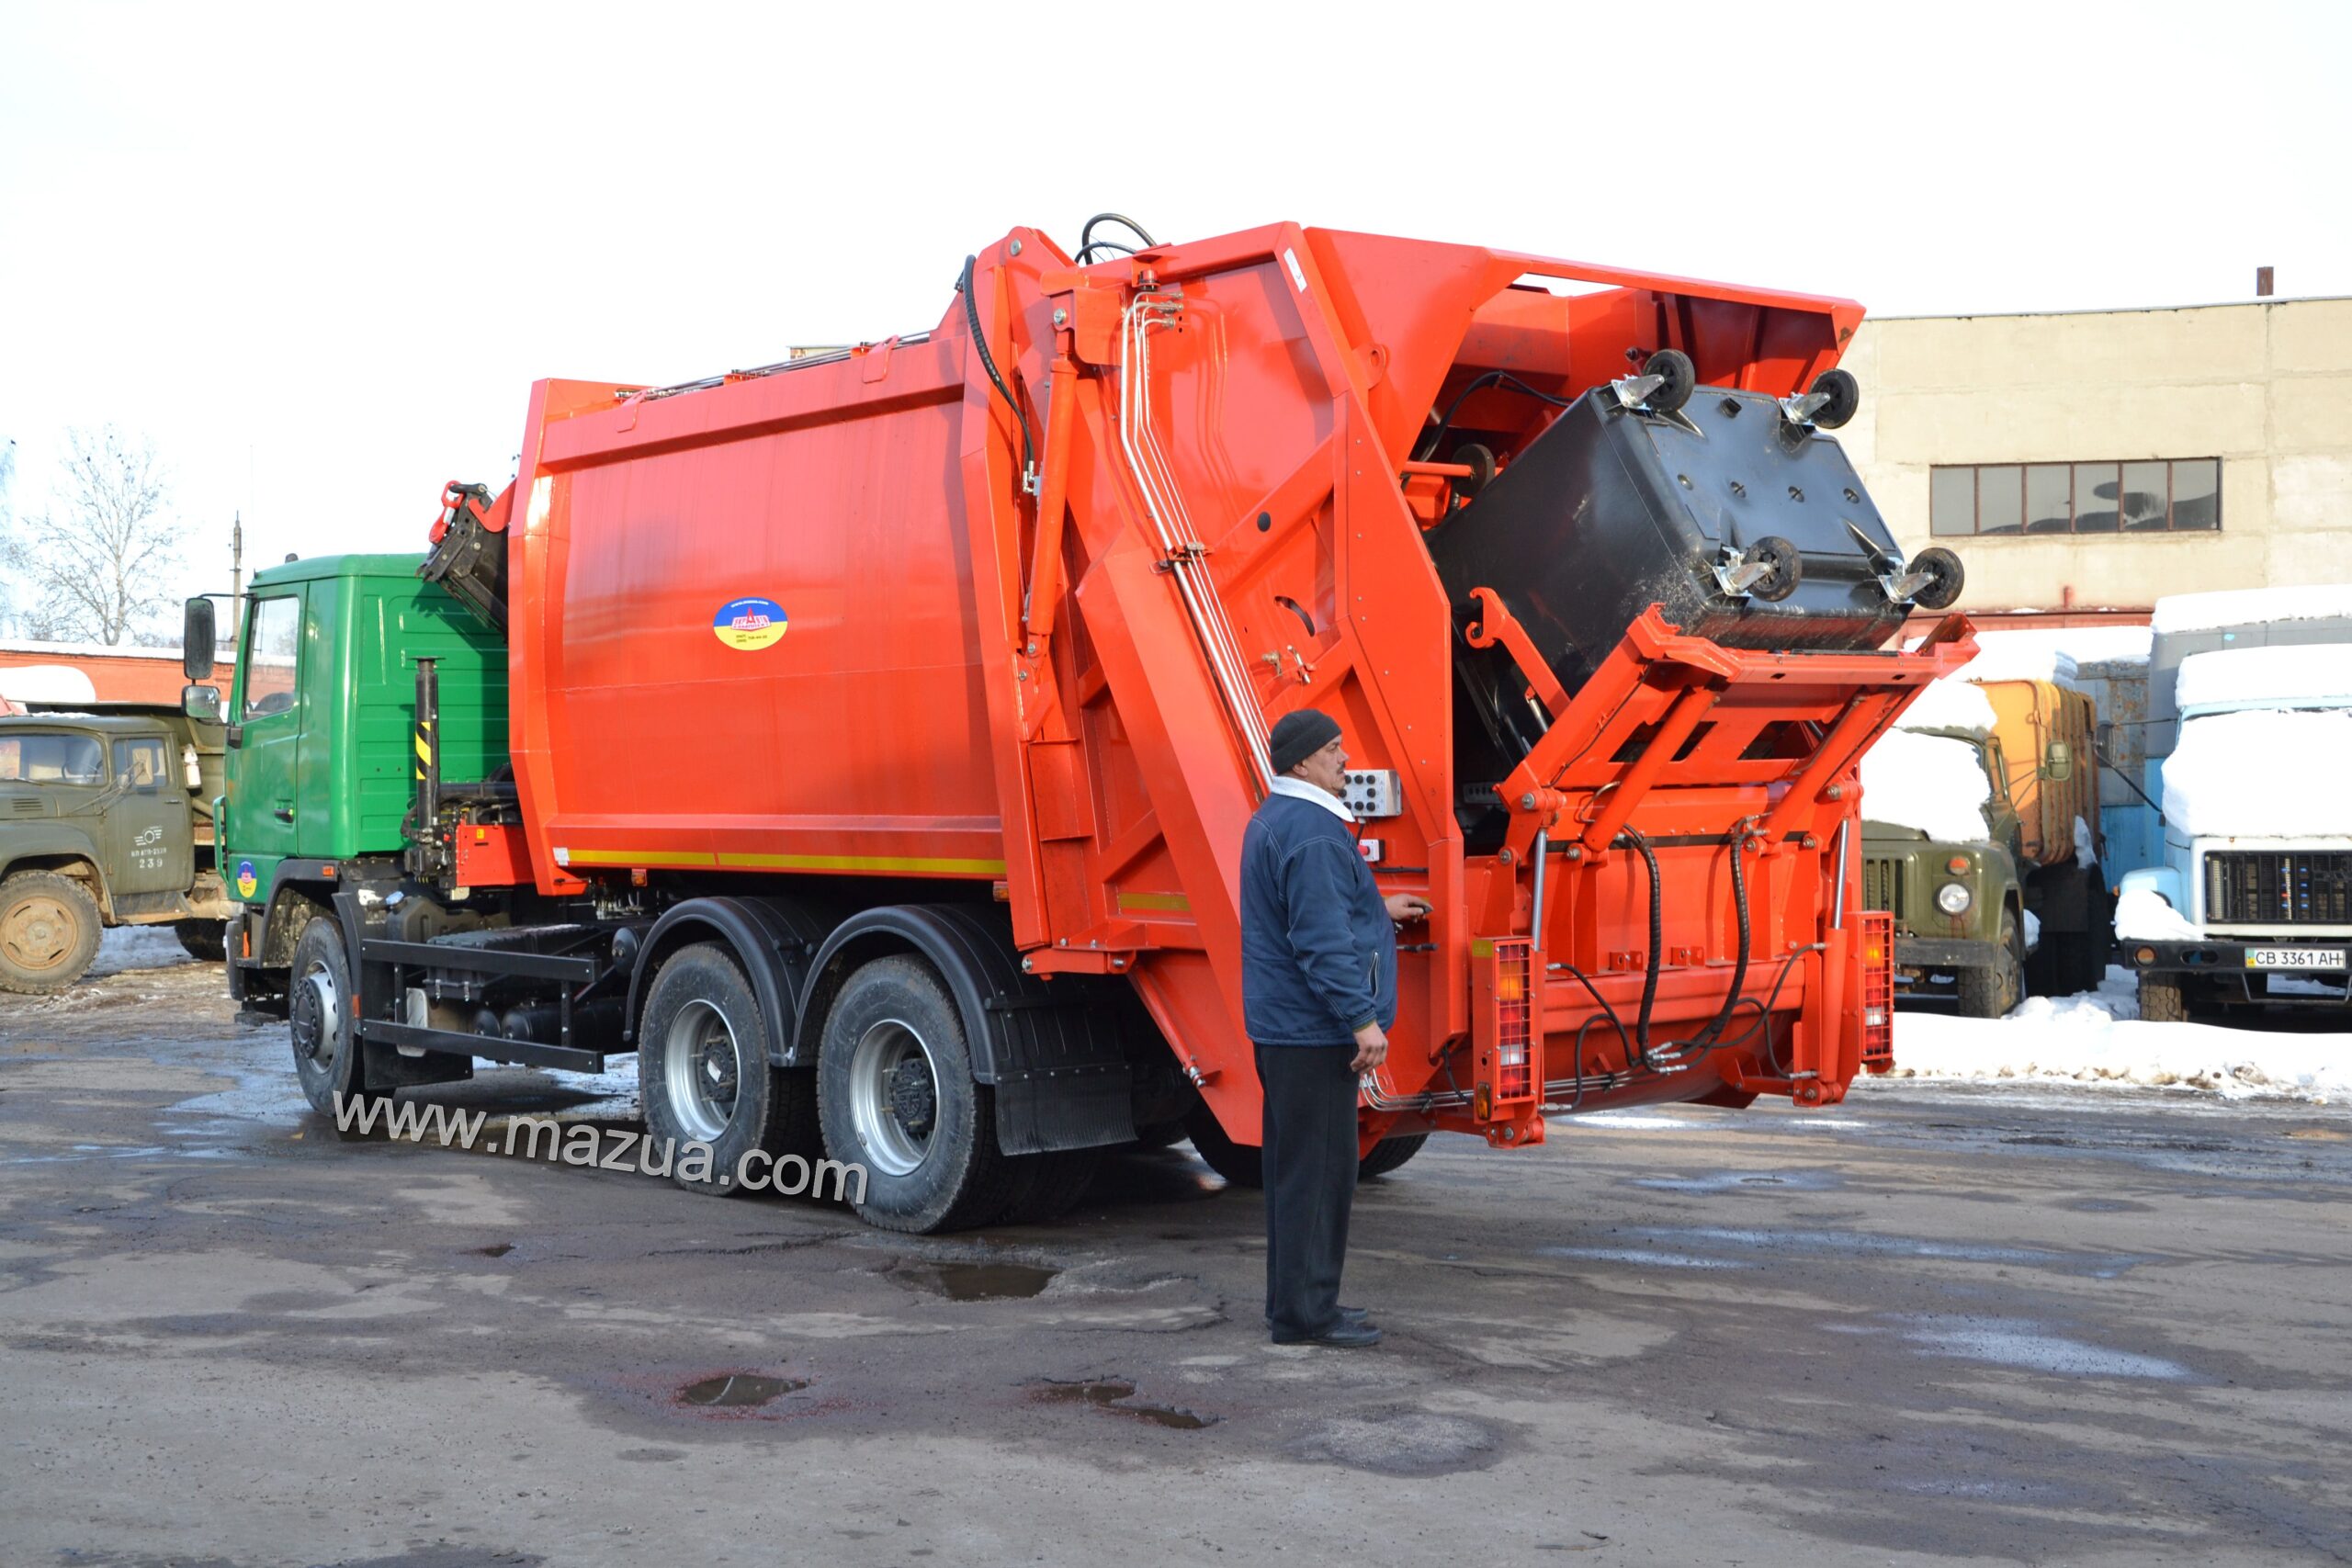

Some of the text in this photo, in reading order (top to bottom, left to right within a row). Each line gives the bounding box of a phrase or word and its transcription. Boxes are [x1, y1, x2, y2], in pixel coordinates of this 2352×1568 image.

[139, 858, 163, 869] 239
[2256, 951, 2340, 965] CB 3361 AH
